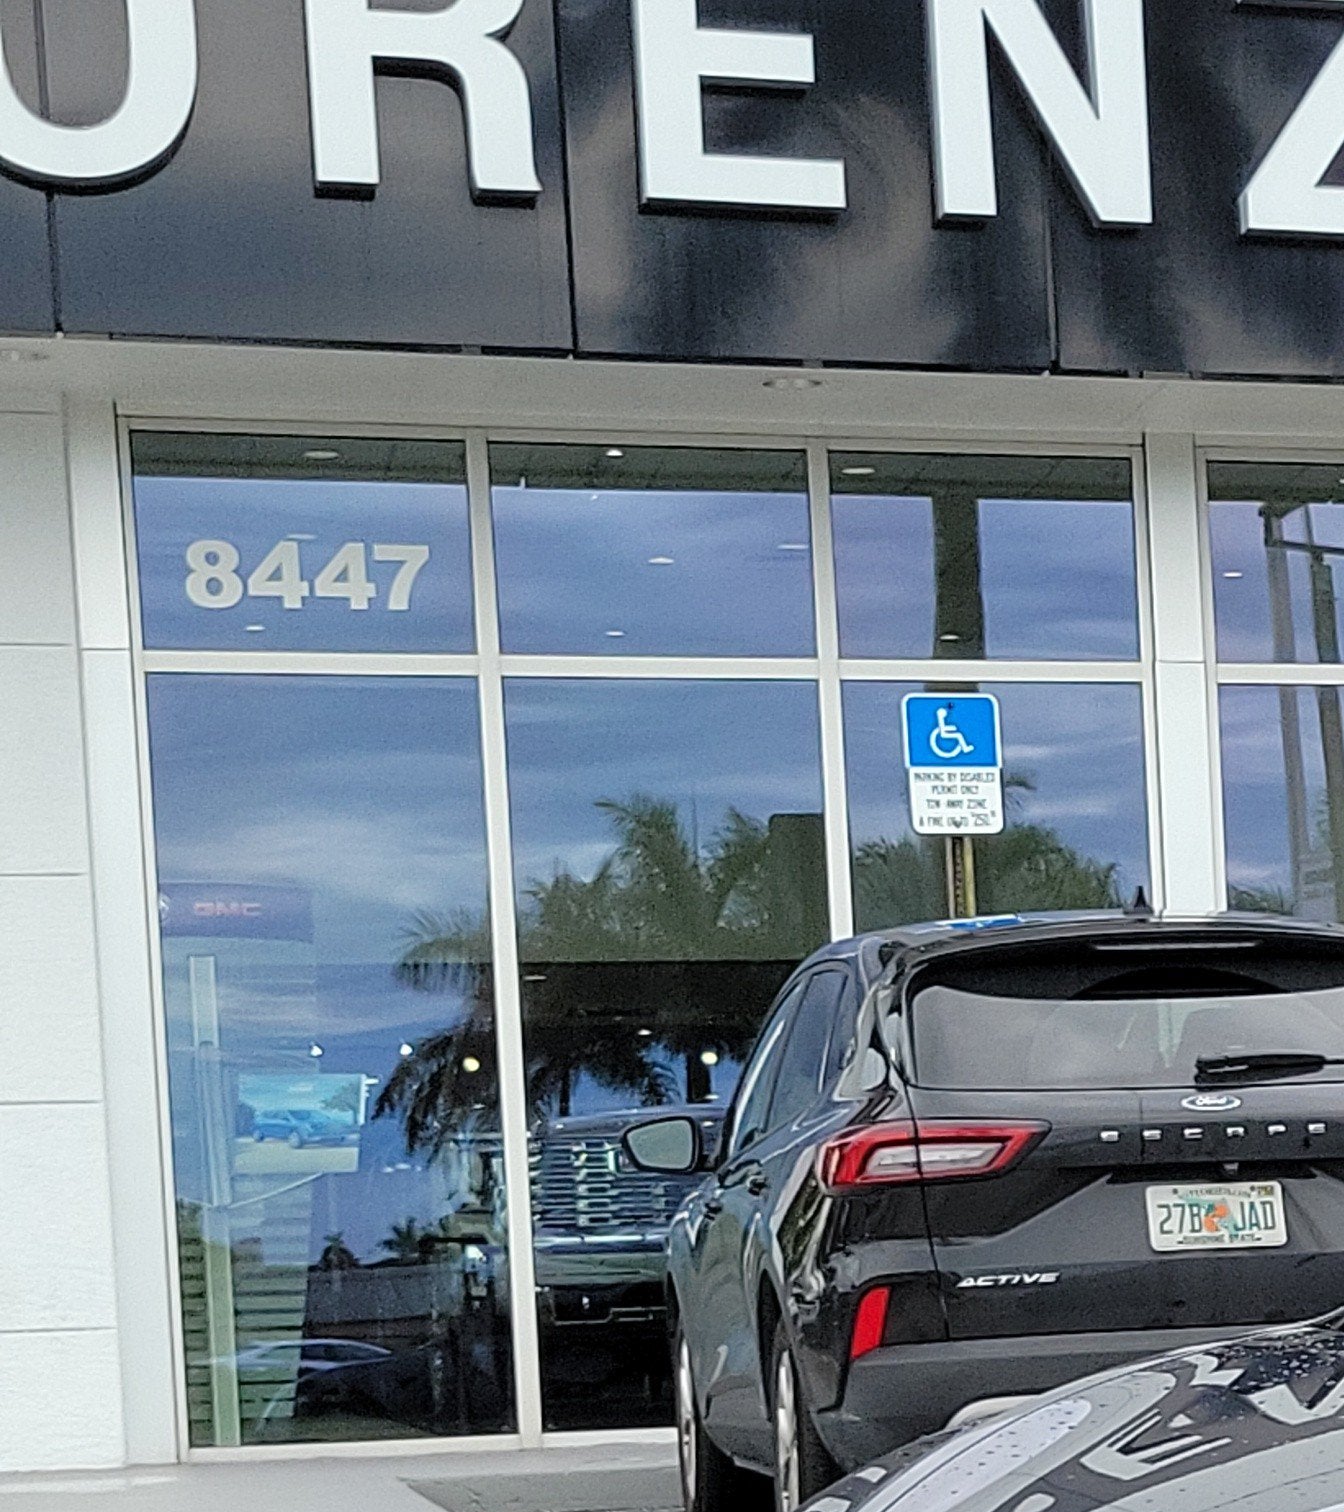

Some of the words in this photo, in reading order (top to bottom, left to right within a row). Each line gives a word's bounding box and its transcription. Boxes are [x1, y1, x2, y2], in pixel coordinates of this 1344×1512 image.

[185, 540, 430, 611] 8447
[1100, 1122, 1327, 1142] ESCAPE
[1157, 1203, 1203, 1235] 27B
[1233, 1200, 1276, 1232] JAD
[956, 1272, 1060, 1288] ACTIVE
